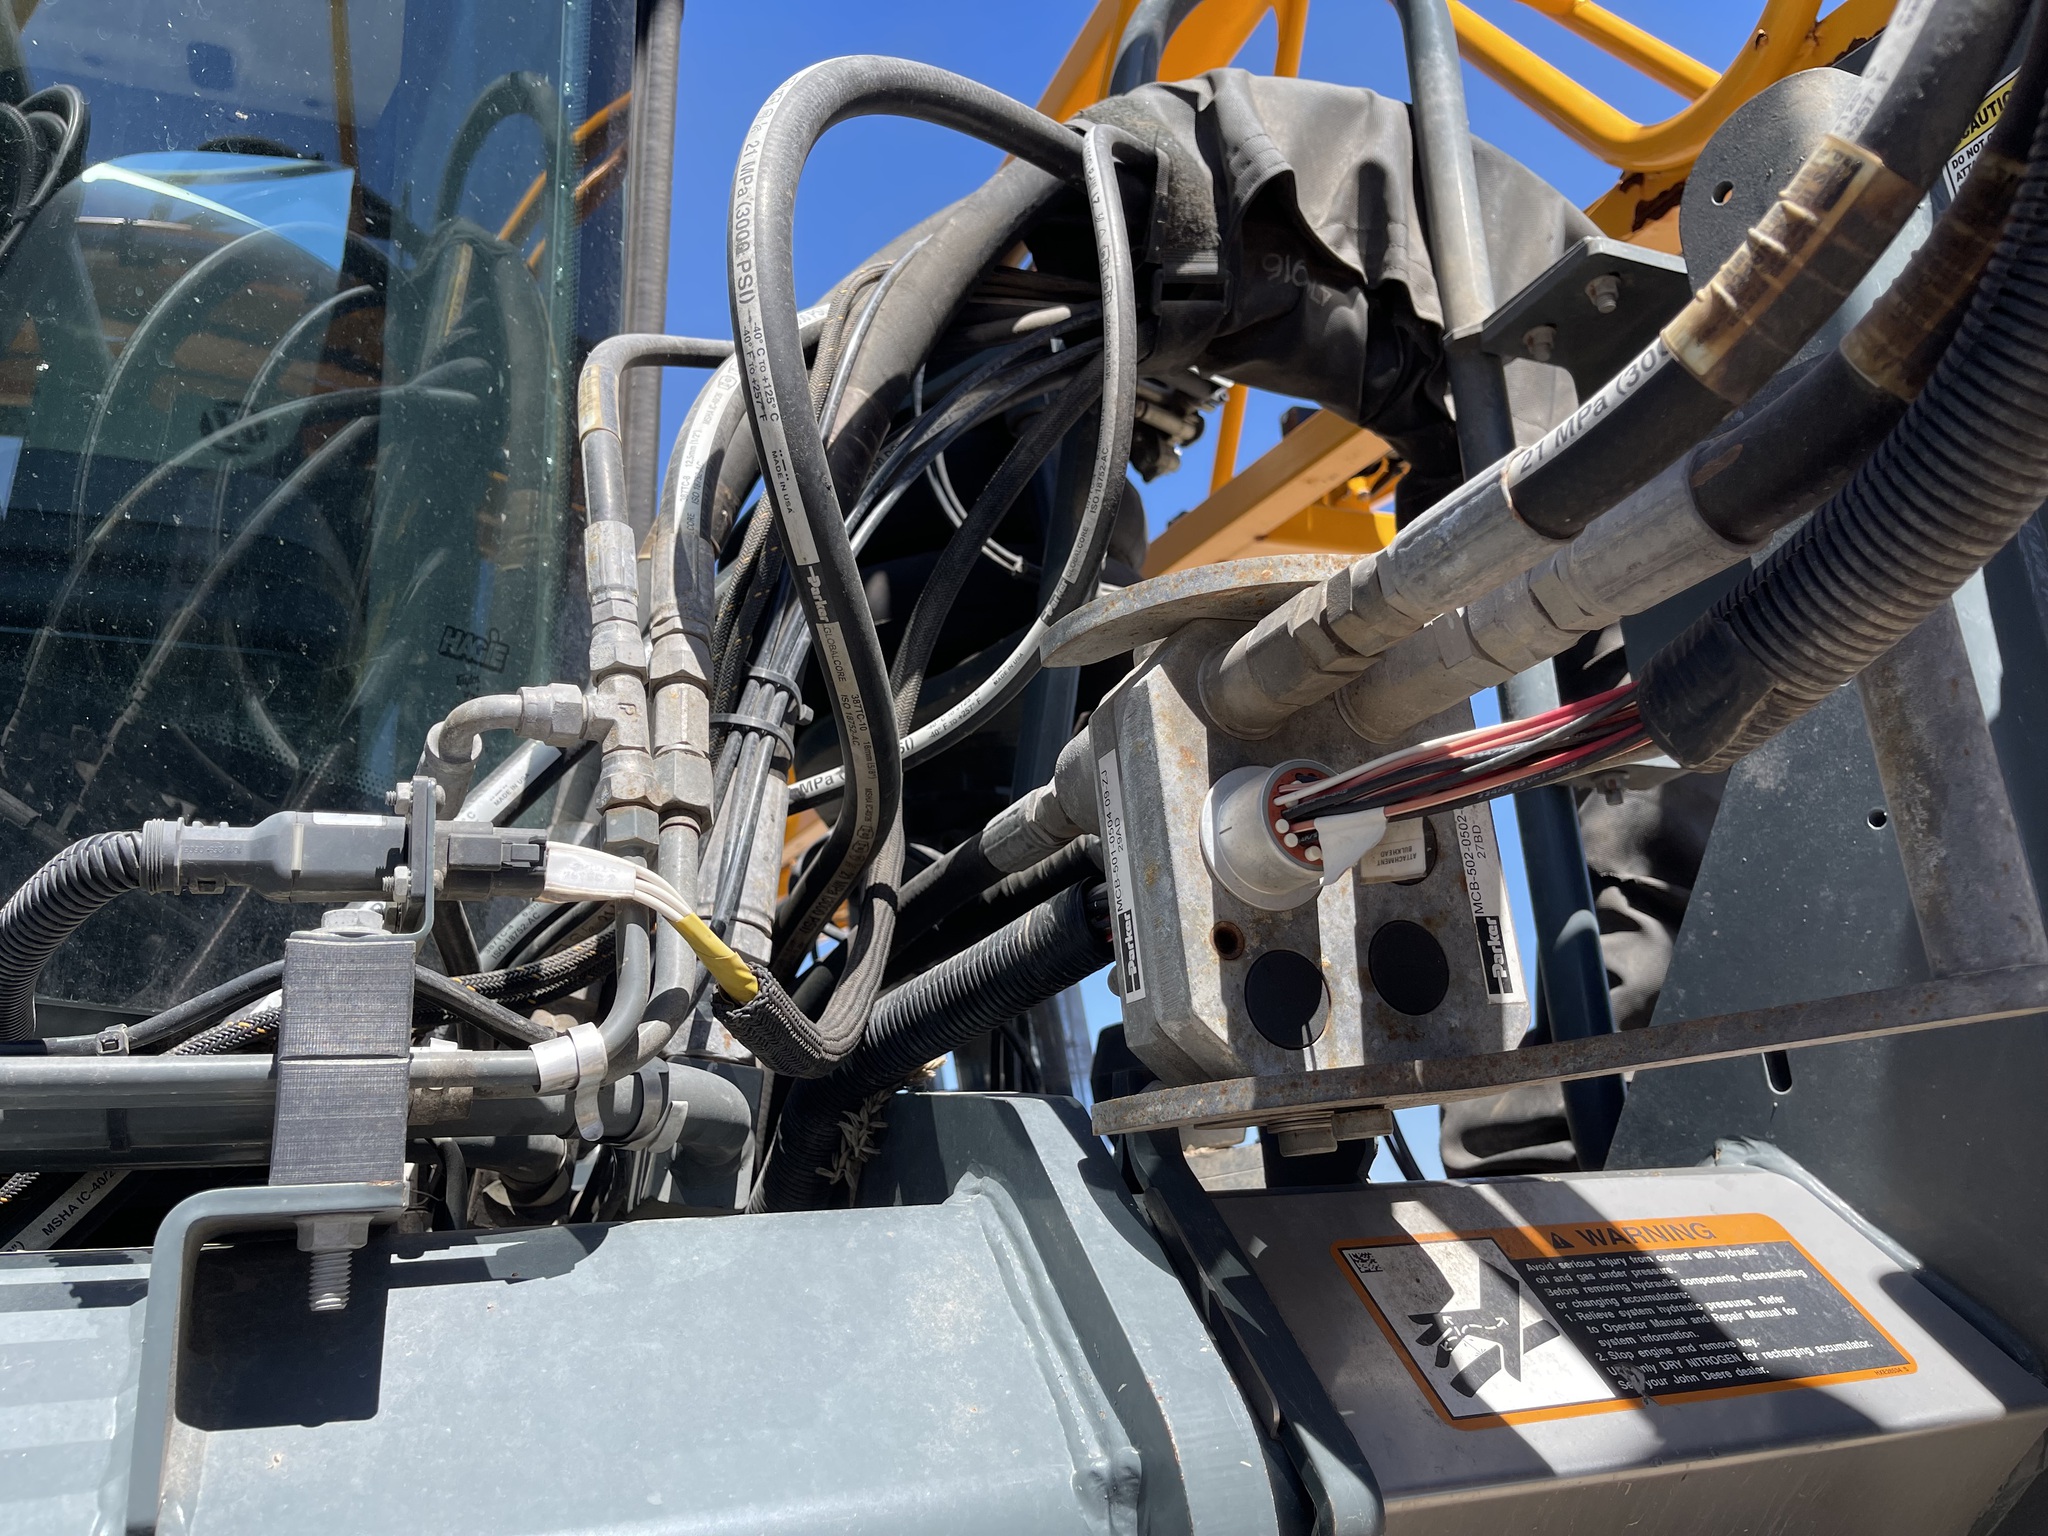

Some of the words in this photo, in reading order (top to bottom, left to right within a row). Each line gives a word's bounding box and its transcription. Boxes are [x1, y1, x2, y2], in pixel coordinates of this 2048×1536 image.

[744, 140, 760, 157] 21
[1951, 154, 1965, 169] DO
[1966, 138, 1985, 159] NOT
[738, 161, 756, 198] MPa
[1956, 161, 1976, 182] ATT
[737, 260, 756, 305] PSI)
[746, 350, 756, 358] F
[759, 413, 768, 422] F
[757, 347, 765, 356] C
[770, 412, 779, 422] C
[1520, 440, 1544, 474] 21
[1555, 394, 1608, 448] MPa
[772, 450, 784, 479] MADE
[1090, 496, 1099, 513] ISO
[1095, 447, 1108, 492] 18752-AC
[780, 481, 787, 491] IN
[783, 493, 793, 514] USA
[1066, 526, 1089, 578] GLOBALCORE
[807, 573, 829, 622] Parker
[1045, 578, 1067, 616] Parker
[438, 625, 510, 674] HAGIE
[823, 627, 847, 682] GLOBALCORE
[993, 670, 1008, 687] MADE
[1007, 664, 1015, 672] IN
[1013, 652, 1024, 665] USA
[841, 694, 851, 709] ISO
[942, 722, 948, 731] F
[976, 697, 982, 705] F
[494, 791, 512, 806] MADE
[510, 783, 518, 791] IN
[800, 776, 834, 794] MPa
[1377, 852, 1417, 866] ATTACHMENT
[1380, 845, 1413, 858] BULKHEAD
[491, 945, 507, 960] ISO
[506, 912, 540, 945] 18752-AC
[1124, 912, 1138, 976] Parker
[1486, 916, 1508, 979] Parker
[42, 1204, 79, 1236] MSHA
[1575, 1221, 1717, 1247] WARNING
[1525, 1262, 1552, 1273] Avoid
[1558, 1258, 1595, 1269] serious
[1599, 1256, 1628, 1269] injury
[1630, 1254, 1652, 1265] from
[1656, 1251, 1692, 1264] contact
[1694, 1250, 1715, 1261] with
[1717, 1247, 1760, 1261] hydraulic
[1535, 1274, 1550, 1285] oil
[1553, 1272, 1573, 1284] and
[1577, 1272, 1596, 1284] gas
[1599, 1269, 1628, 1281] under
[1631, 1266, 1678, 1280] pressure.
[1545, 1286, 1580, 1298] Before
[1583, 1281, 1632, 1296] removing
[1632, 1278, 1678, 1292] hydraulic
[1680, 1273, 1741, 1288] components,
[1742, 1267, 1809, 1283] disassembling
[1556, 1300, 1568, 1310] or
[1572, 1295, 1620, 1310] changing
[1622, 1290, 1691, 1305] accumulators:
[1565, 1313, 1577, 1323] 1.
[1578, 1309, 1615, 1322] Relieve
[1618, 1307, 1654, 1321] system
[1658, 1302, 1703, 1316] hydraulic
[1705, 1297, 1757, 1313] pressures.
[1758, 1294, 1786, 1306] Refer
[1587, 1324, 1600, 1335] to
[1604, 1320, 1649, 1335] Operator
[1651, 1315, 1688, 1328] Manual
[1690, 1313, 1710, 1325] and
[1711, 1310, 1745, 1325] Repair
[1746, 1306, 1782, 1320] Manual
[1784, 1305, 1799, 1316] for
[1595, 1352, 1609, 1362] 2.
[1609, 1348, 1635, 1362] Stop
[1638, 1344, 1673, 1359] engine
[1676, 1342, 1697, 1354] and
[1698, 1339, 1737, 1352] remove
[1736, 1335, 1760, 1349] key.
[1597, 1335, 1635, 1349] system
[1639, 1328, 1700, 1343] information.
[1660, 1359, 1684, 1372] DRY
[1686, 1352, 1742, 1369] NITROGEN
[1743, 1351, 1760, 1362] for
[1762, 1345, 1814, 1360] recharging
[1815, 1338, 1874, 1354] accumulator.
[1647, 1376, 1670, 1390] your
[1672, 1371, 1700, 1385] John
[1703, 1370, 1733, 1383] Deere
[1735, 1364, 1770, 1378] dealer.
